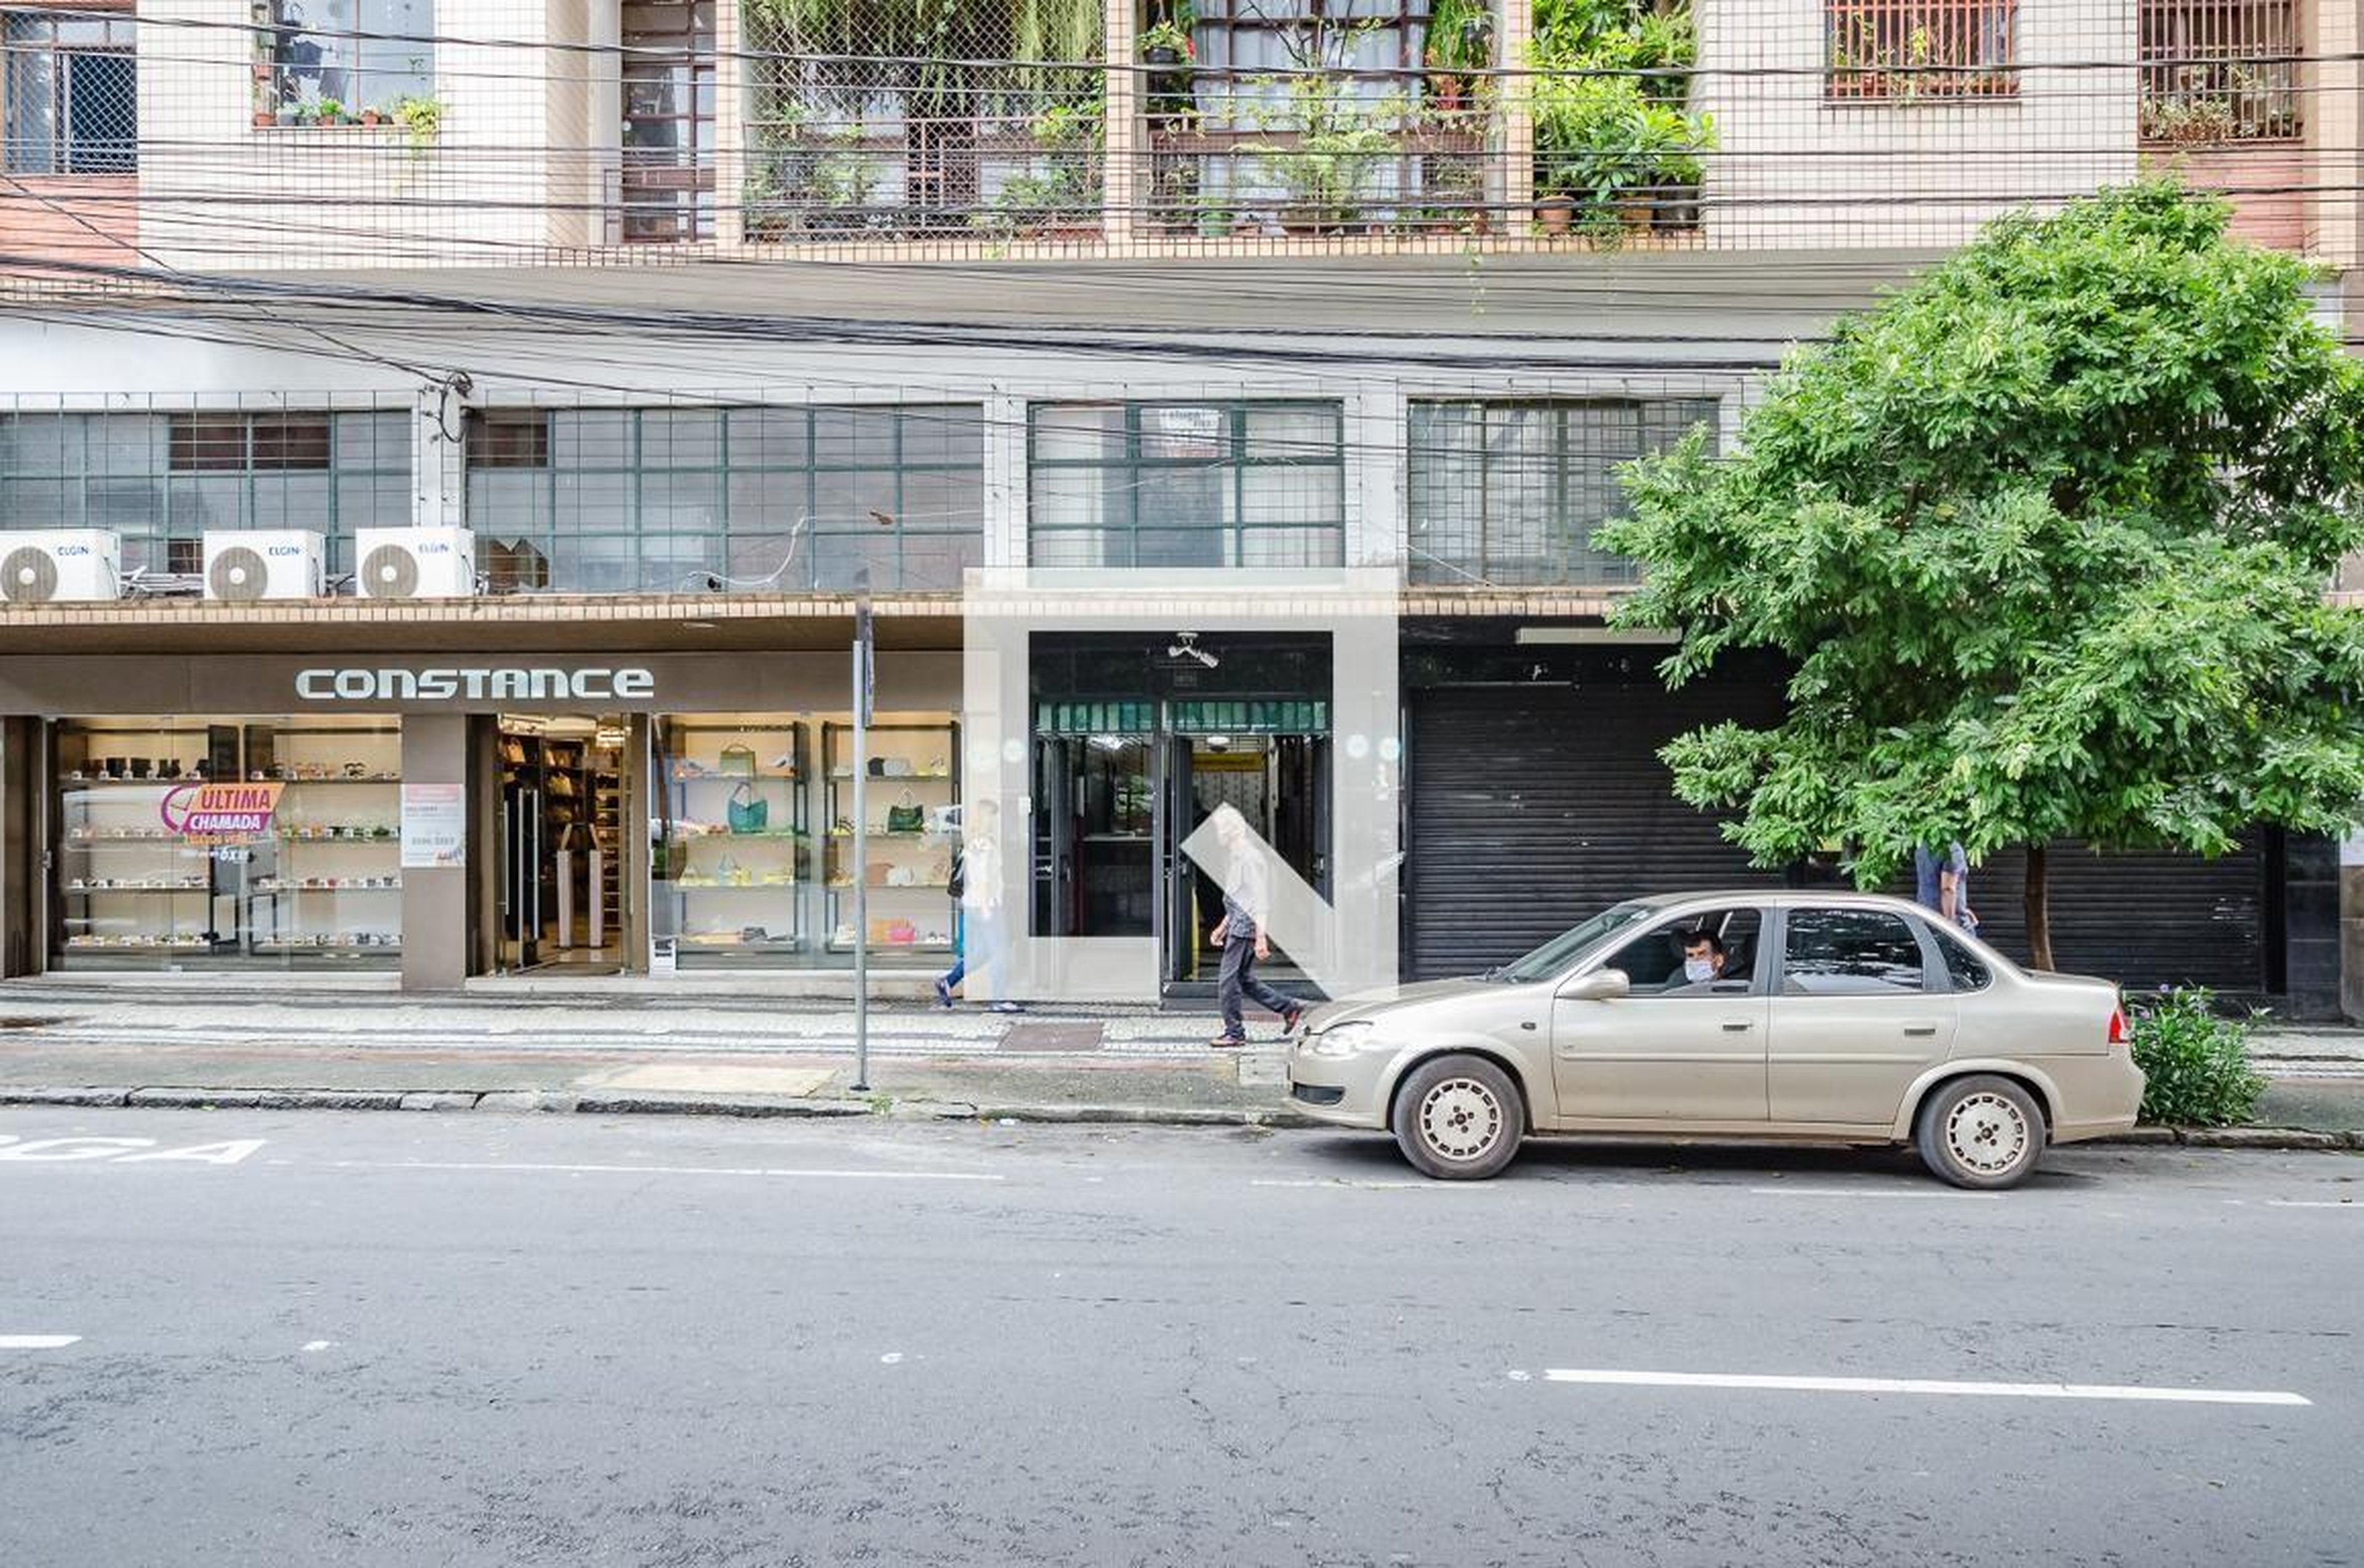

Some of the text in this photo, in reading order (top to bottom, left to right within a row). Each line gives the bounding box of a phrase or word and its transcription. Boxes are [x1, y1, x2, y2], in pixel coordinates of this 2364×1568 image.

[58, 546, 89, 555] ELGIN
[268, 547, 299, 555] ELGIN
[190, 814, 260, 830] CHAMADA
